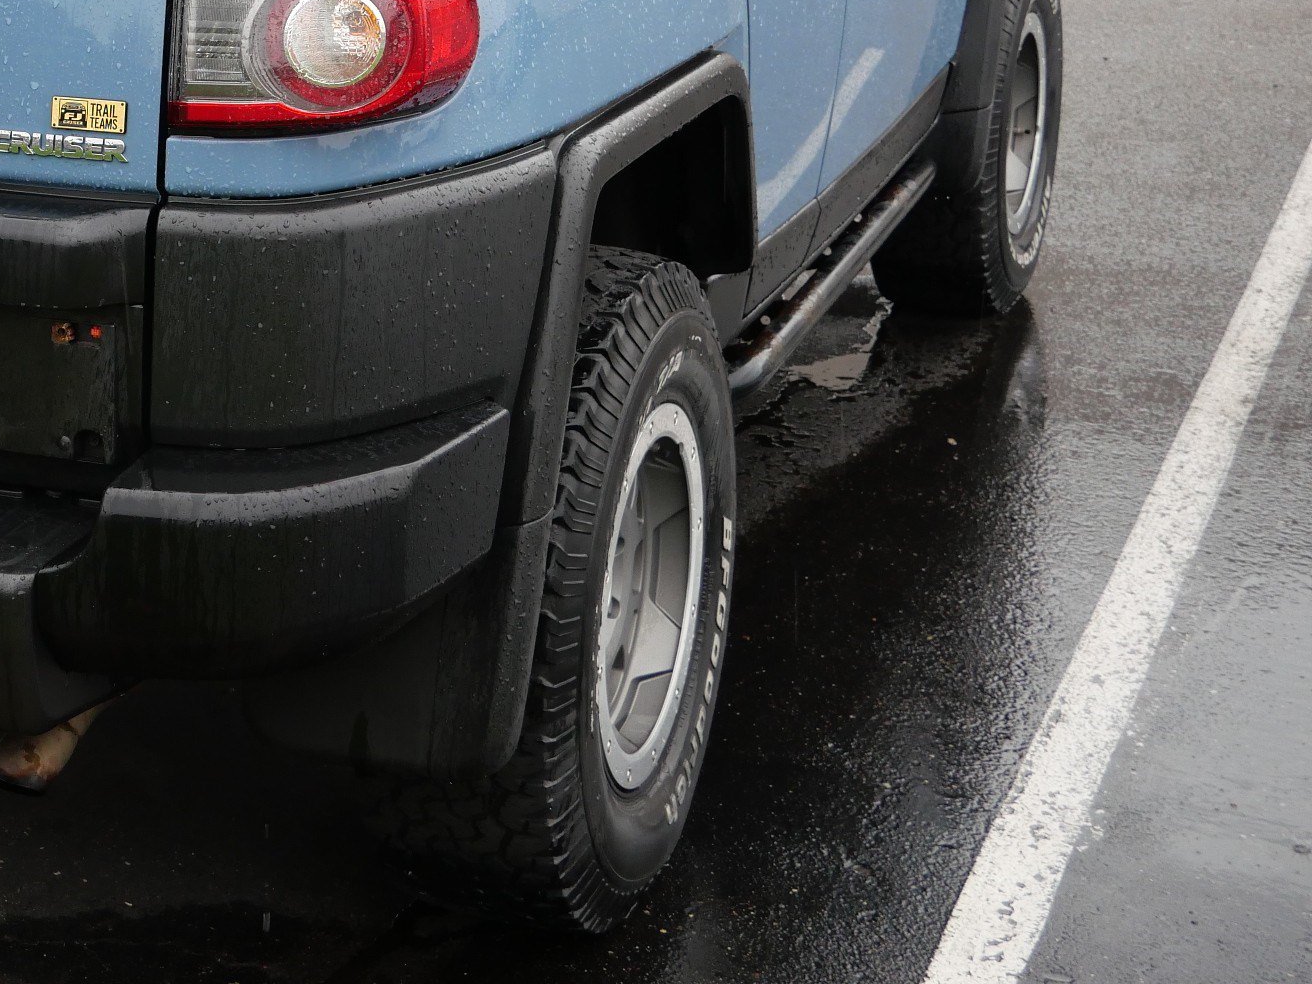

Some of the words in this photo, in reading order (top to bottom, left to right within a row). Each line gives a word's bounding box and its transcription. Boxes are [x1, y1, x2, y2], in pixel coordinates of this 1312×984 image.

[63, 112, 83, 121] FJ
[90, 103, 118, 118] TRAIL
[89, 116, 118, 130] TEAMS
[664, 516, 733, 825] BFGoodrich
